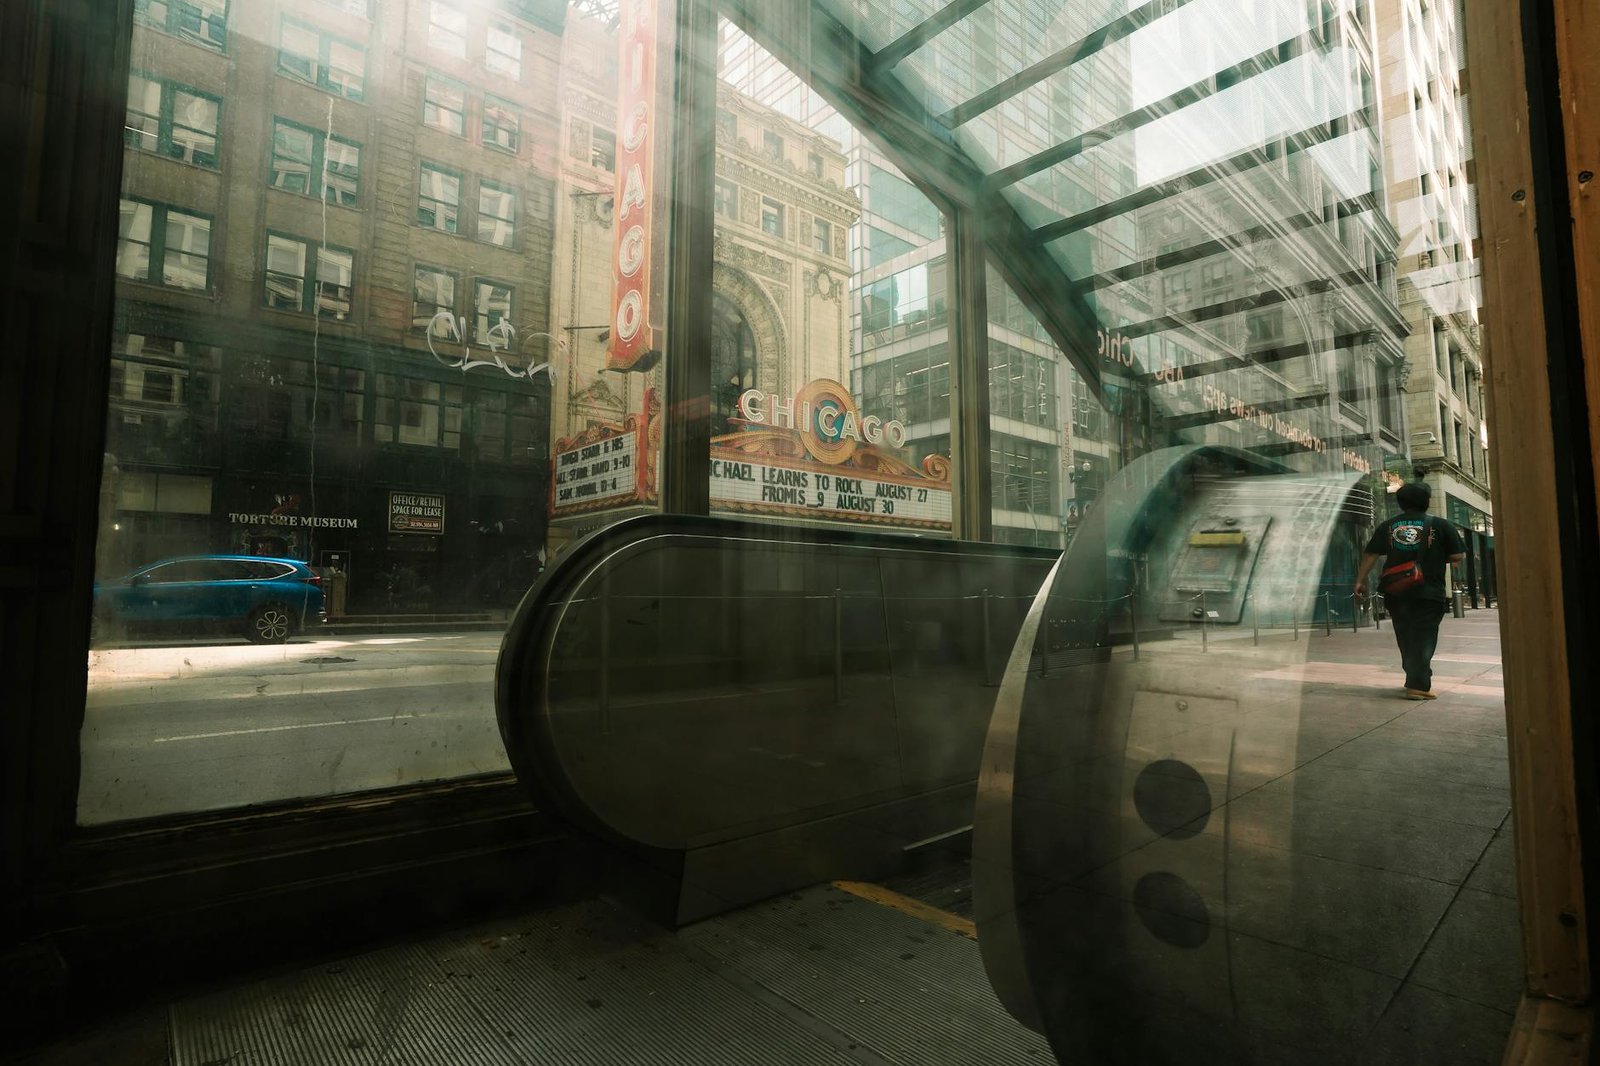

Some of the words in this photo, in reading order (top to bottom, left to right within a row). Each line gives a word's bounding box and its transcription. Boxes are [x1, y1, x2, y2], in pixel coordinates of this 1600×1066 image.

[738, 389, 906, 449] CHICAGO
[709, 458, 755, 482] ICHAEL
[762, 467, 808, 488] LEARNS
[814, 474, 829, 491] TO
[835, 476, 862, 495] ROCK
[875, 483, 913, 502] AUGUST
[917, 489, 928, 503] 27
[392, 494, 442, 508] OFFICE/RETAIL
[836, 495, 876, 513] AUGUST
[881, 500, 894, 514] 30
[392, 505, 410, 515] SPACE
[411, 506, 423, 516] FOR
[424, 506, 442, 517] LEASE
[300, 516, 359, 529] MUSEUM
